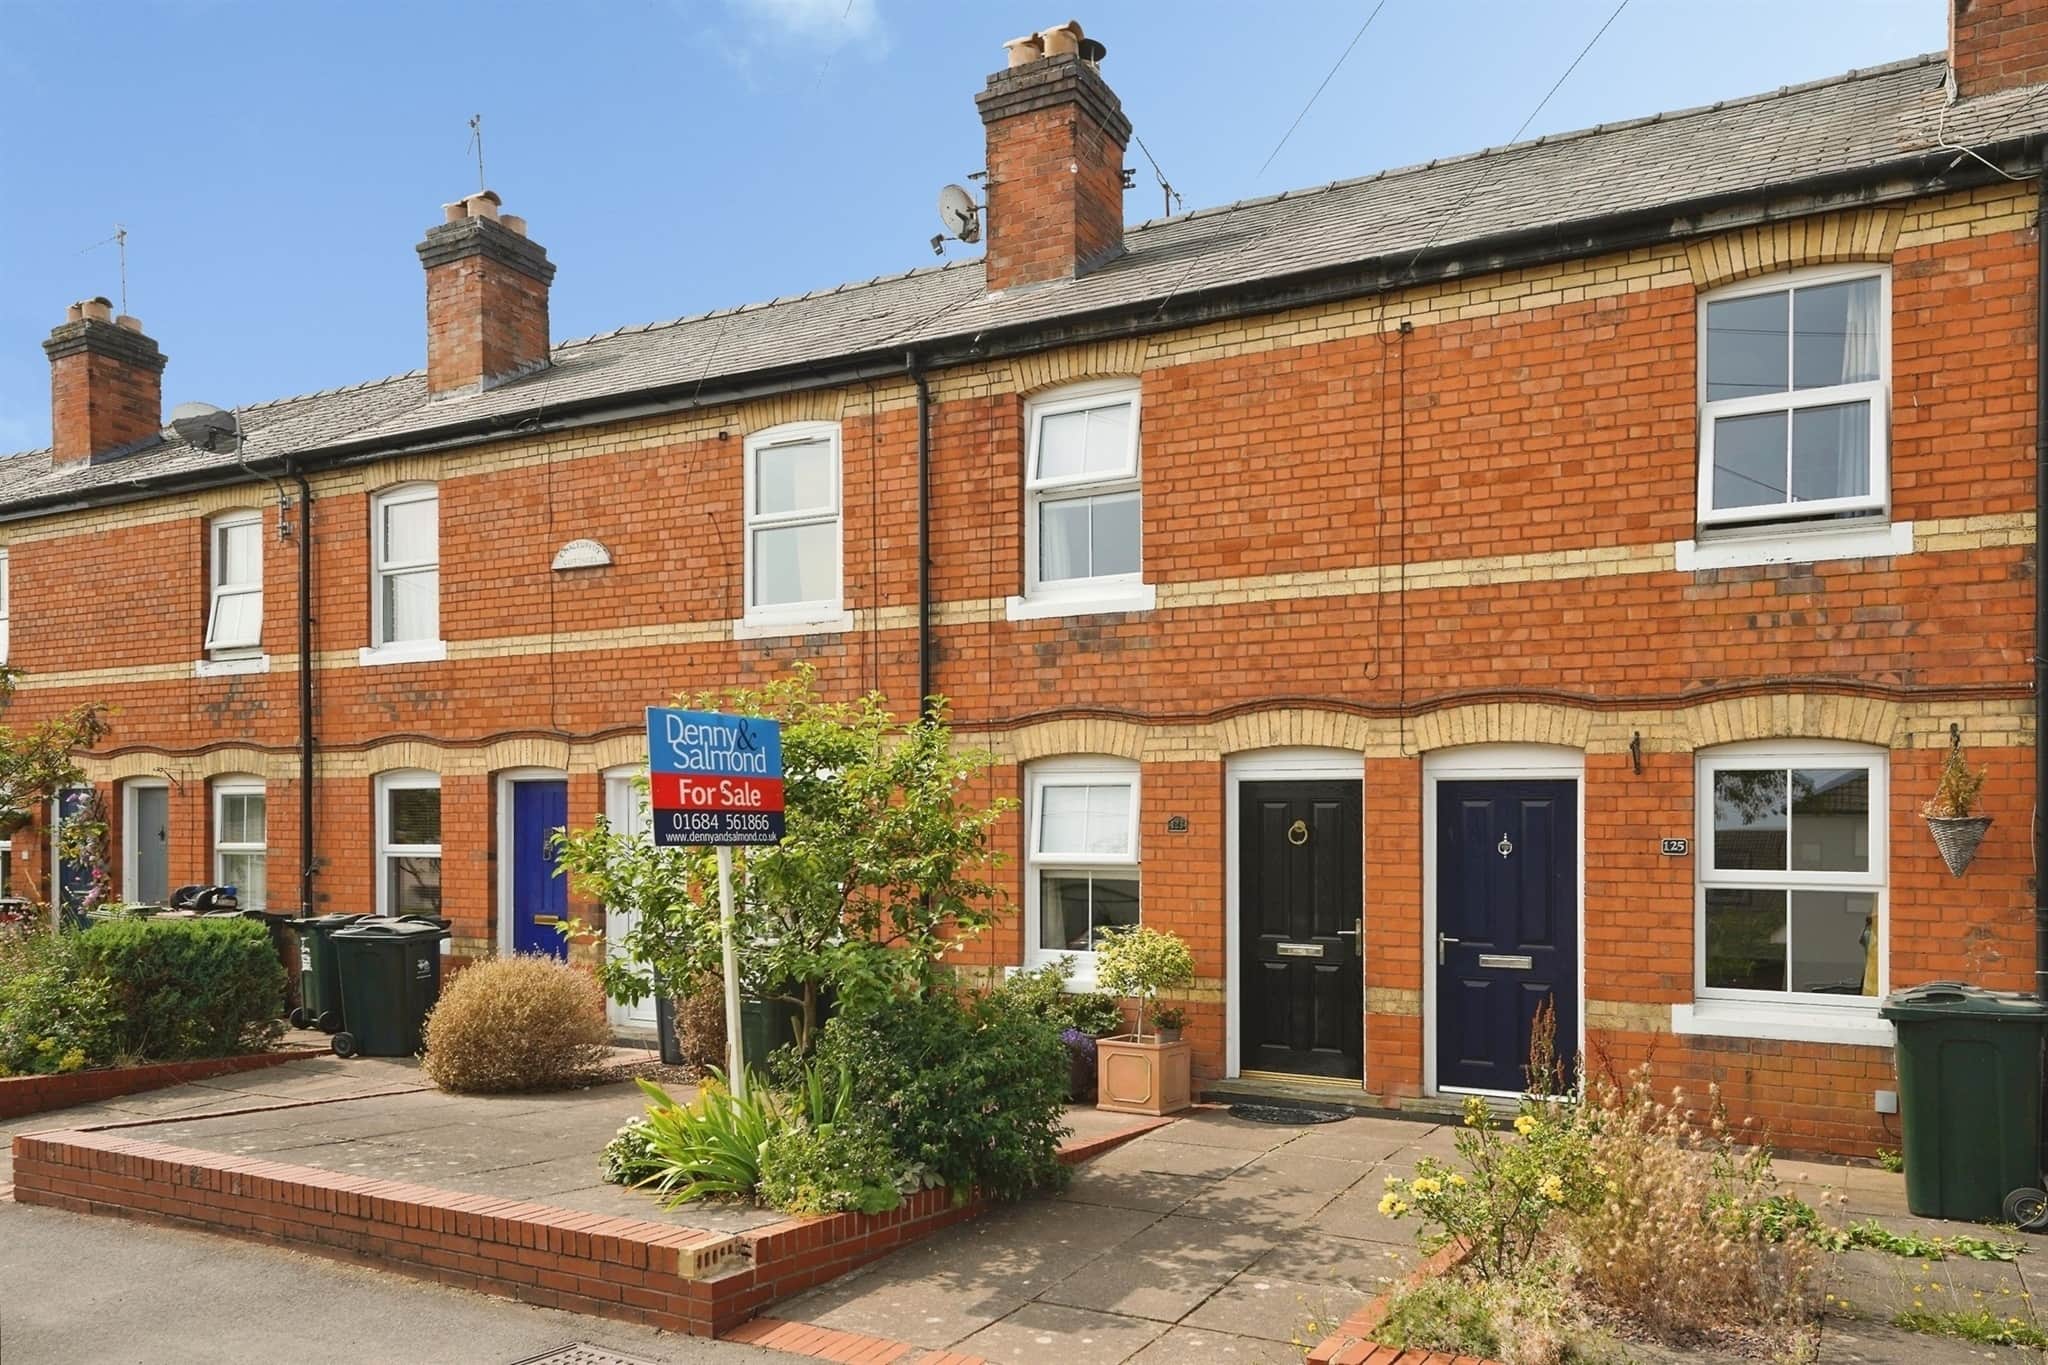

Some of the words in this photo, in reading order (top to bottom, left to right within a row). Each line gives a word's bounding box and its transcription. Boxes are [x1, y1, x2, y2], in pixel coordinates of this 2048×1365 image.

[666, 714, 737, 752] Denny
[737, 719, 757, 751] &
[673, 742, 767, 773] Salmond
[679, 779, 716, 805] For
[720, 780, 761, 806] Sale
[673, 813, 718, 829] 01684
[726, 814, 769, 830] 561866
[666, 831, 777, 843] www.dennyandsalmond.co.uk
[1664, 841, 1685, 852] 125
